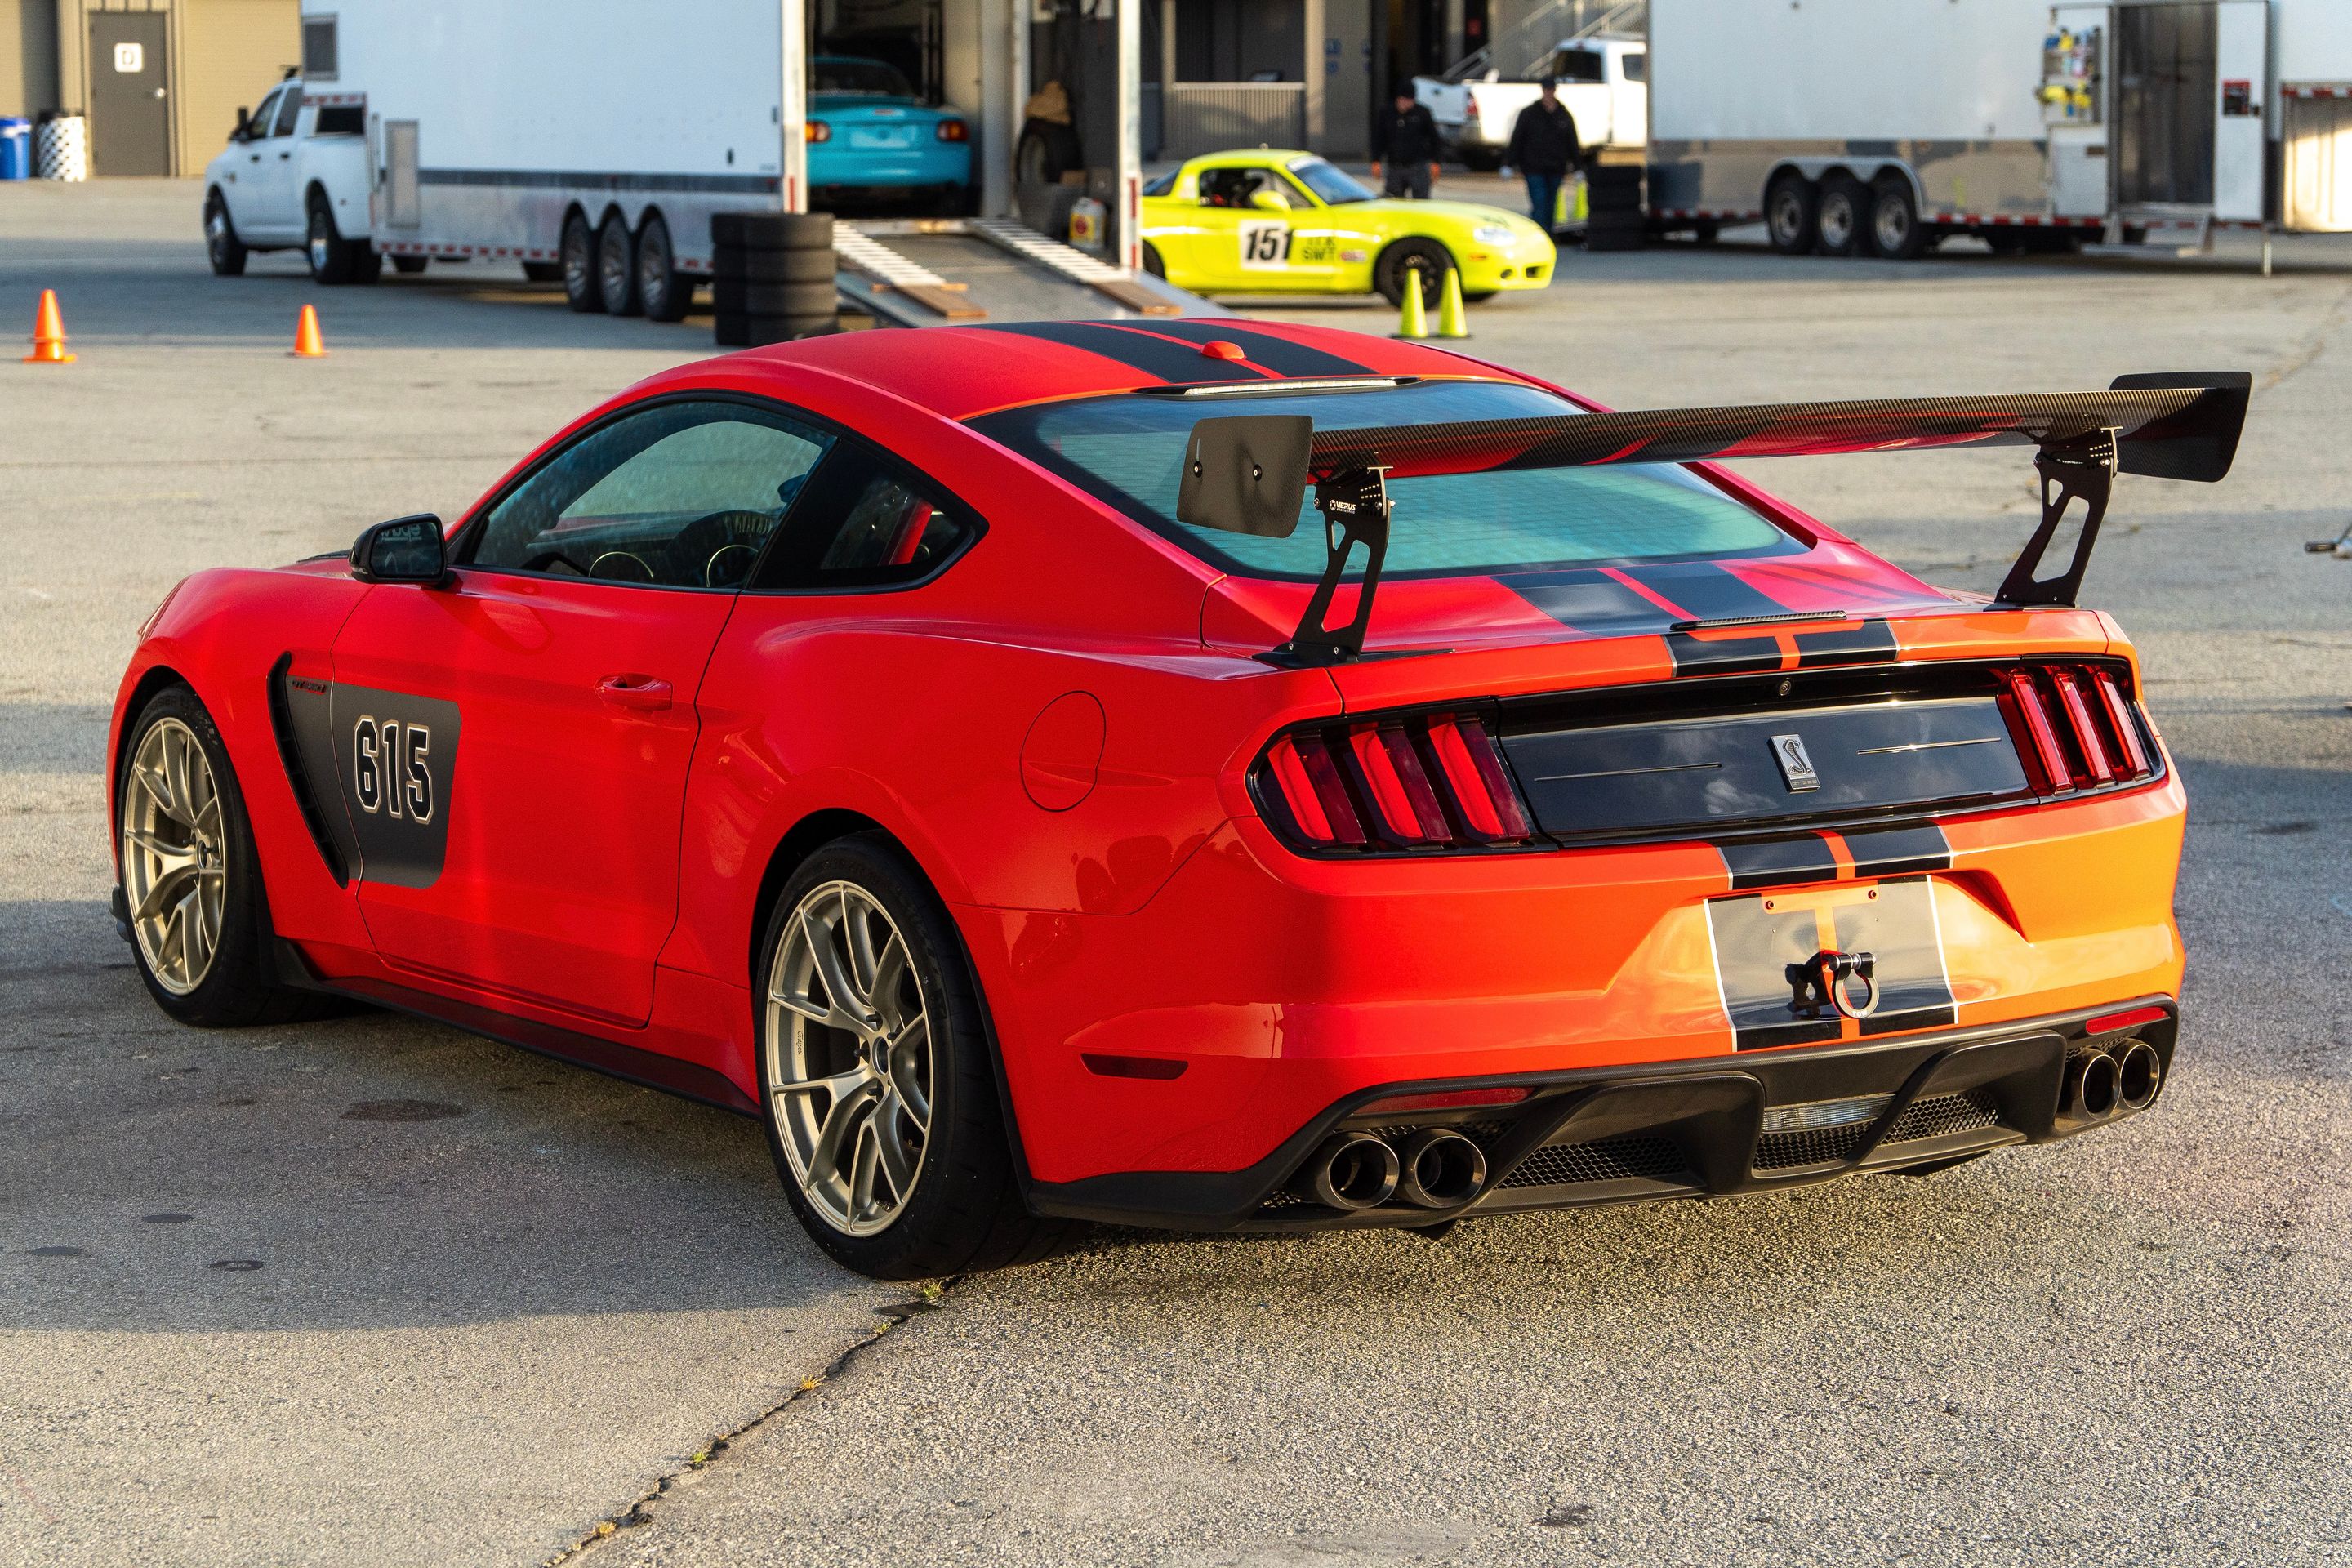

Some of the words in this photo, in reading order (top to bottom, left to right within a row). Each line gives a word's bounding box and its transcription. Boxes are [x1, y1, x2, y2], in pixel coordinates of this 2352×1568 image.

[1247, 228, 1294, 260] 151
[1335, 501, 1356, 511] VERUS
[354, 715, 434, 825] 615
